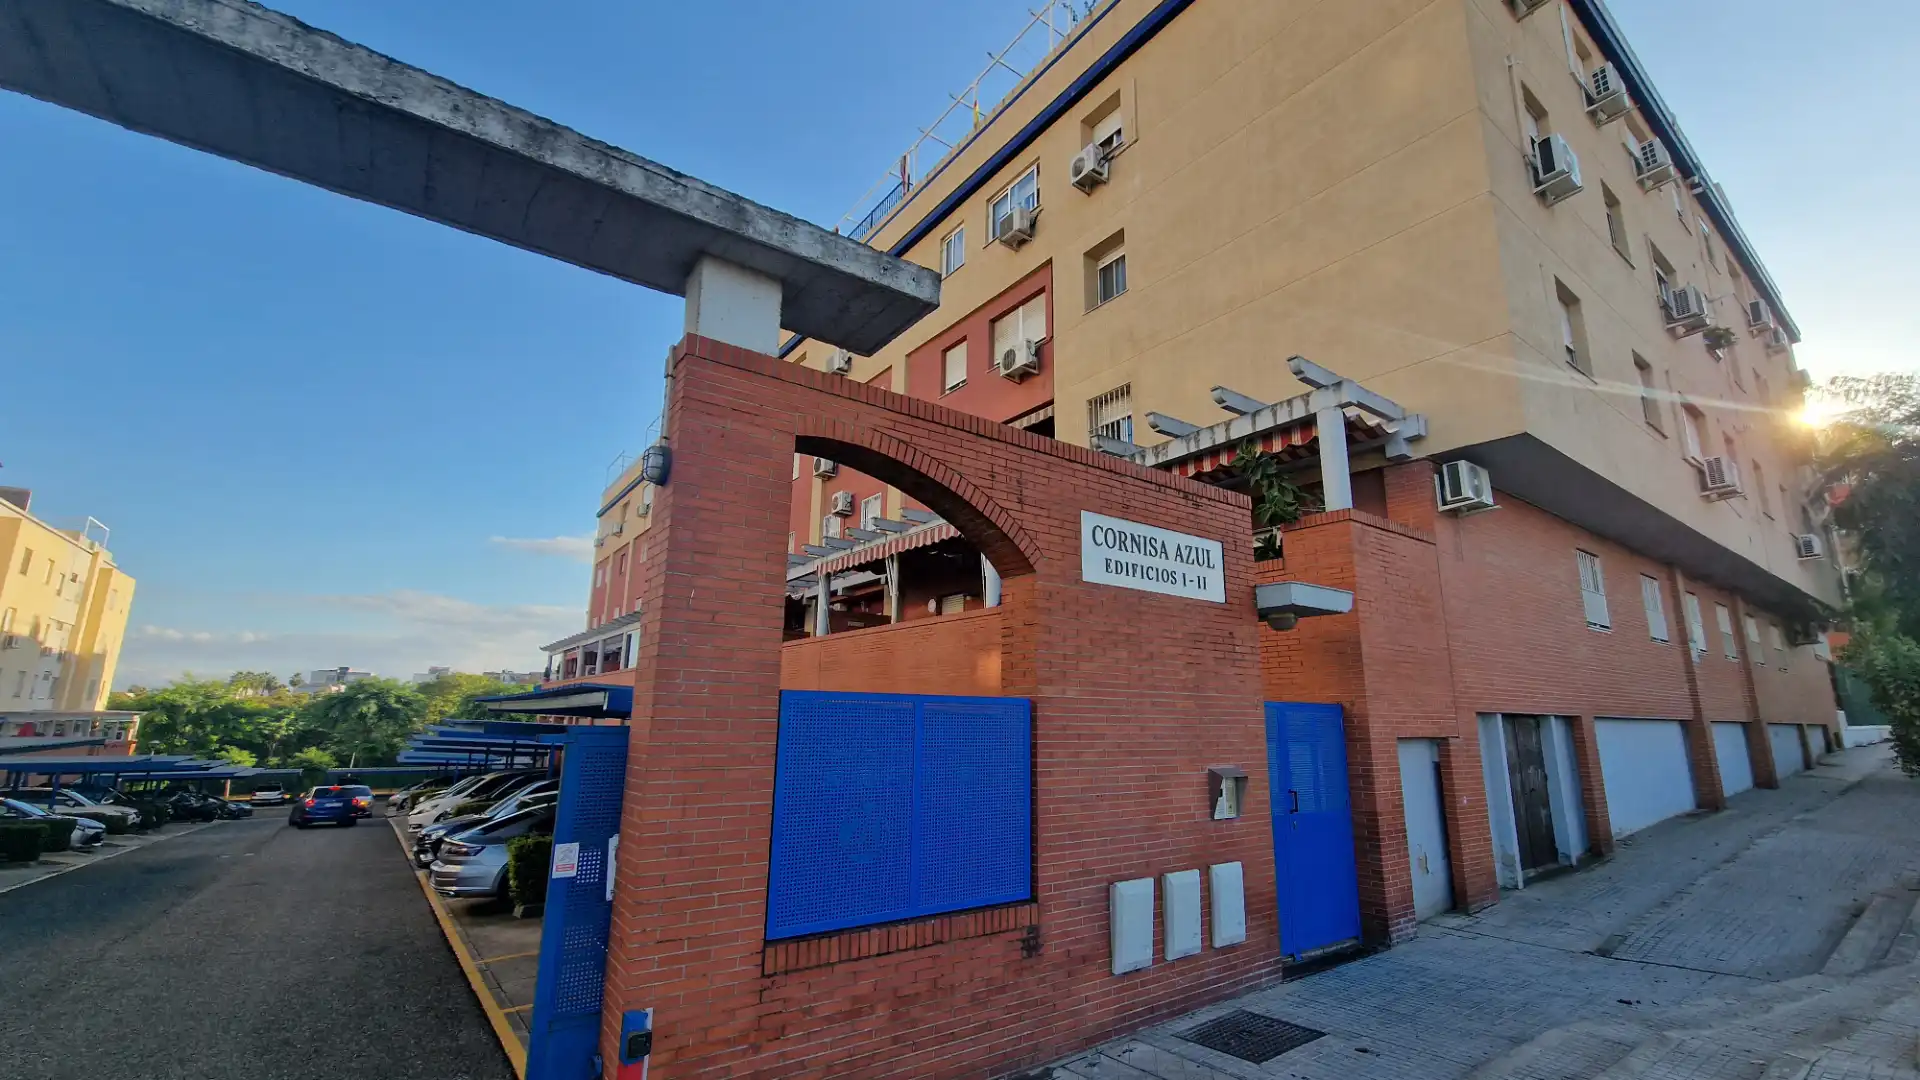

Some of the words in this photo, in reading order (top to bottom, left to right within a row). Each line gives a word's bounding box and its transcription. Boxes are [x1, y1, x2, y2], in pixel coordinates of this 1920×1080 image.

[1091, 524, 1170, 561] CORNISA
[1174, 543, 1216, 569] AZUL
[1104, 557, 1178, 585] EDIFICIOS
